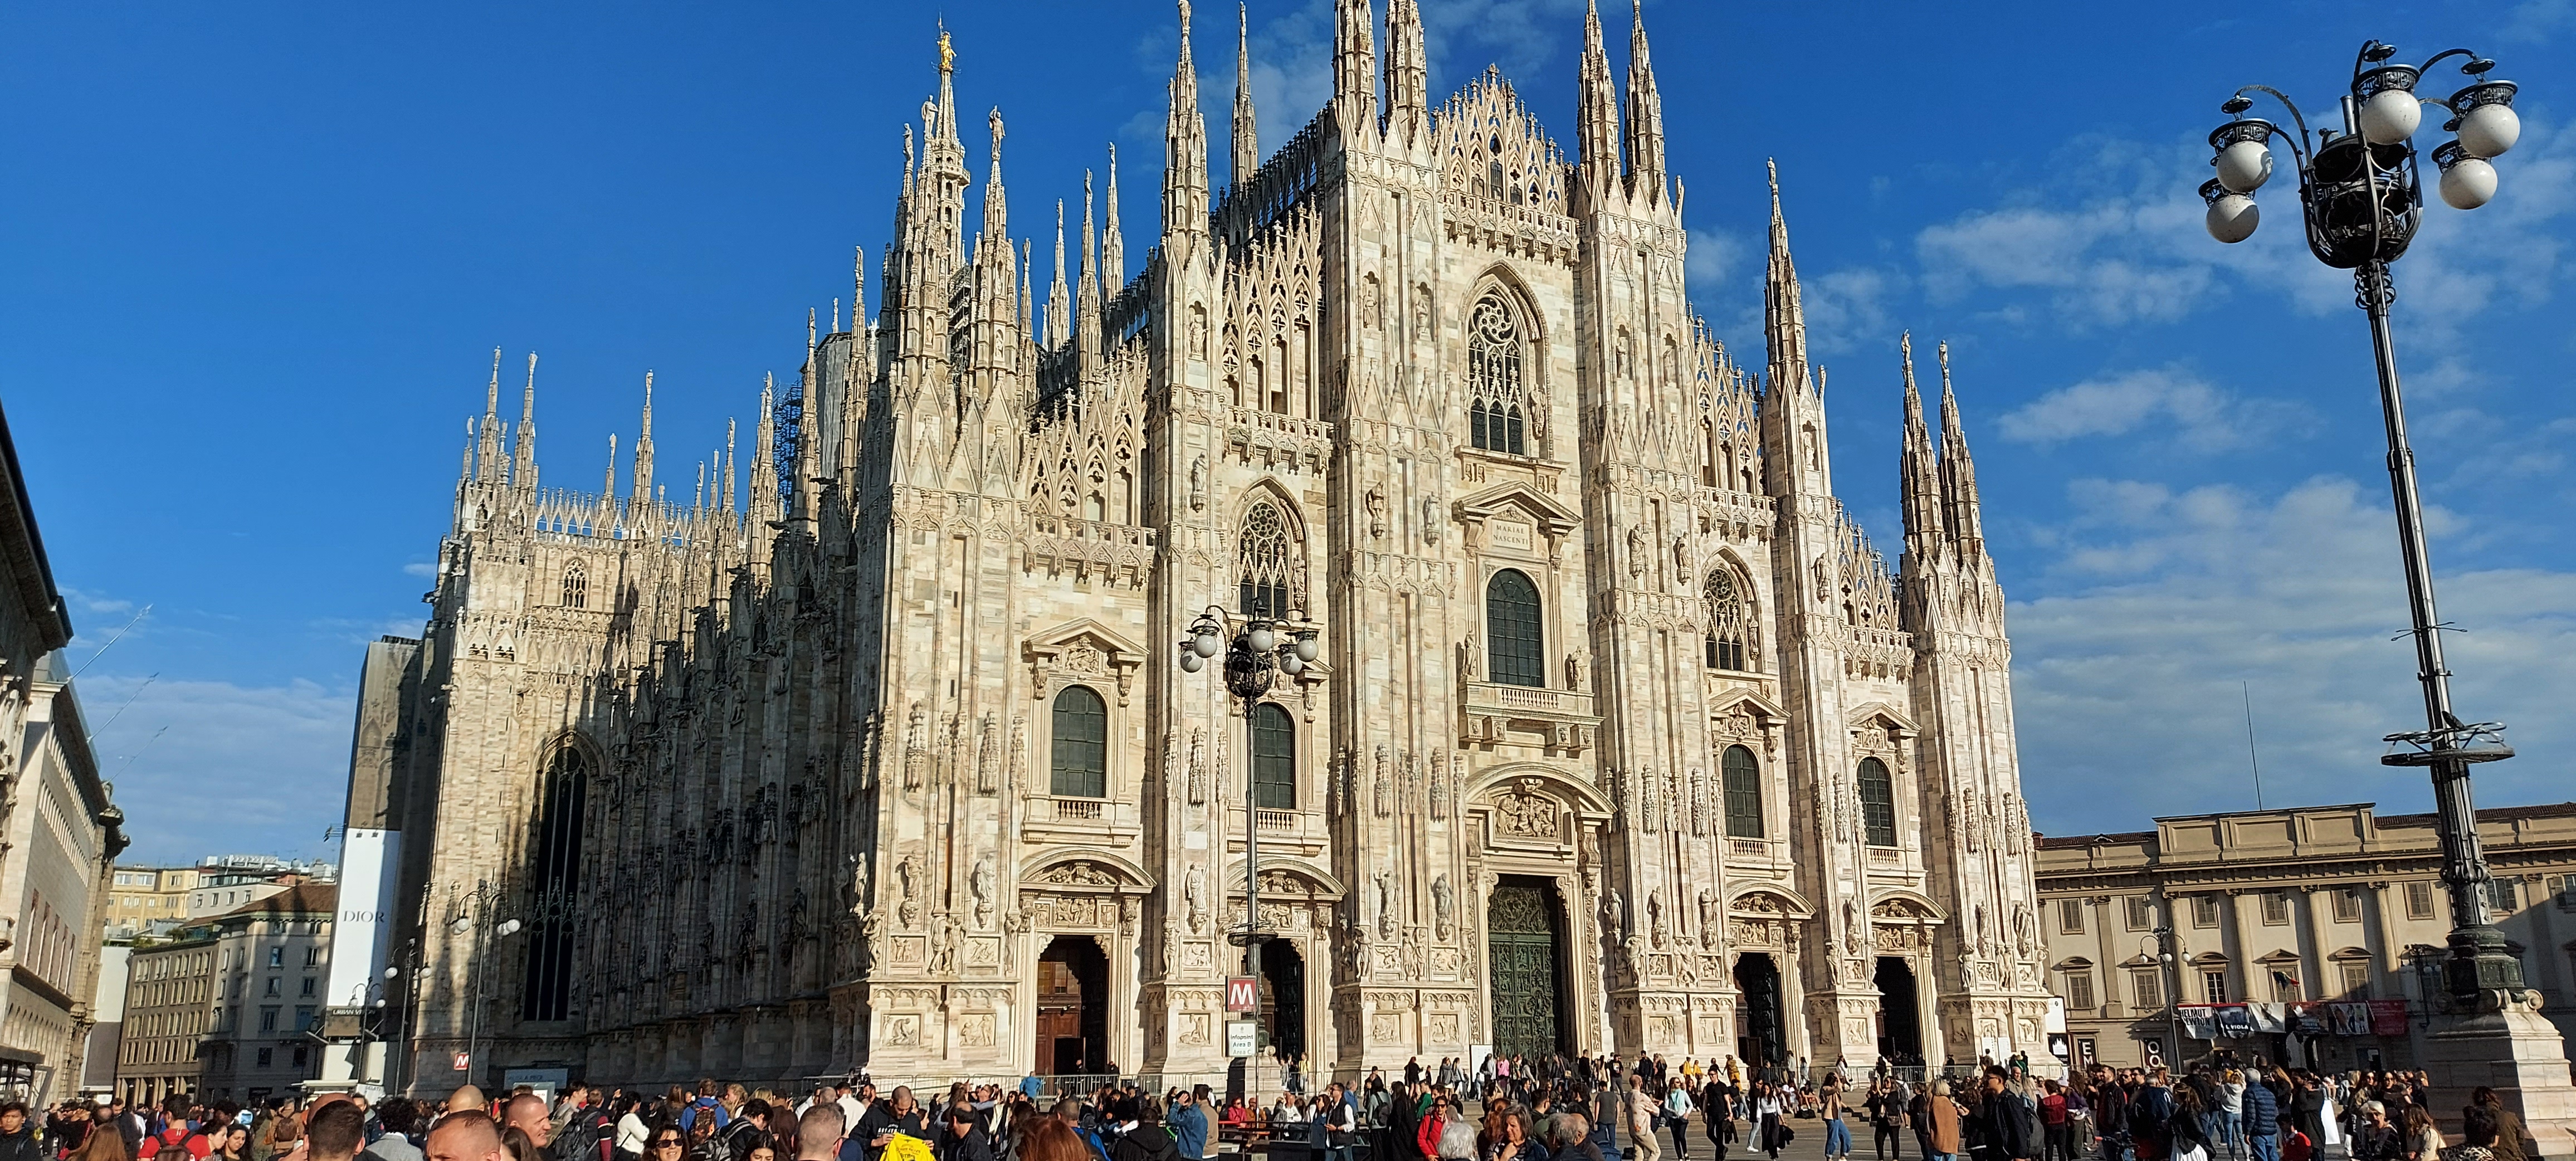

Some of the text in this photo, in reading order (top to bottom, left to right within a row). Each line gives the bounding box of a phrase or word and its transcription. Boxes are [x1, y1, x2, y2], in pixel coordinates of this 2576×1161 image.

[1496, 525, 1524, 534] MARIAE
[1494, 534, 1528, 545] NASCENTI
[343, 911, 384, 923] DIOR
[1230, 983, 1254, 1005] M
[2179, 1008, 2206, 1017] HELMUT
[456, 1055, 469, 1066] M
